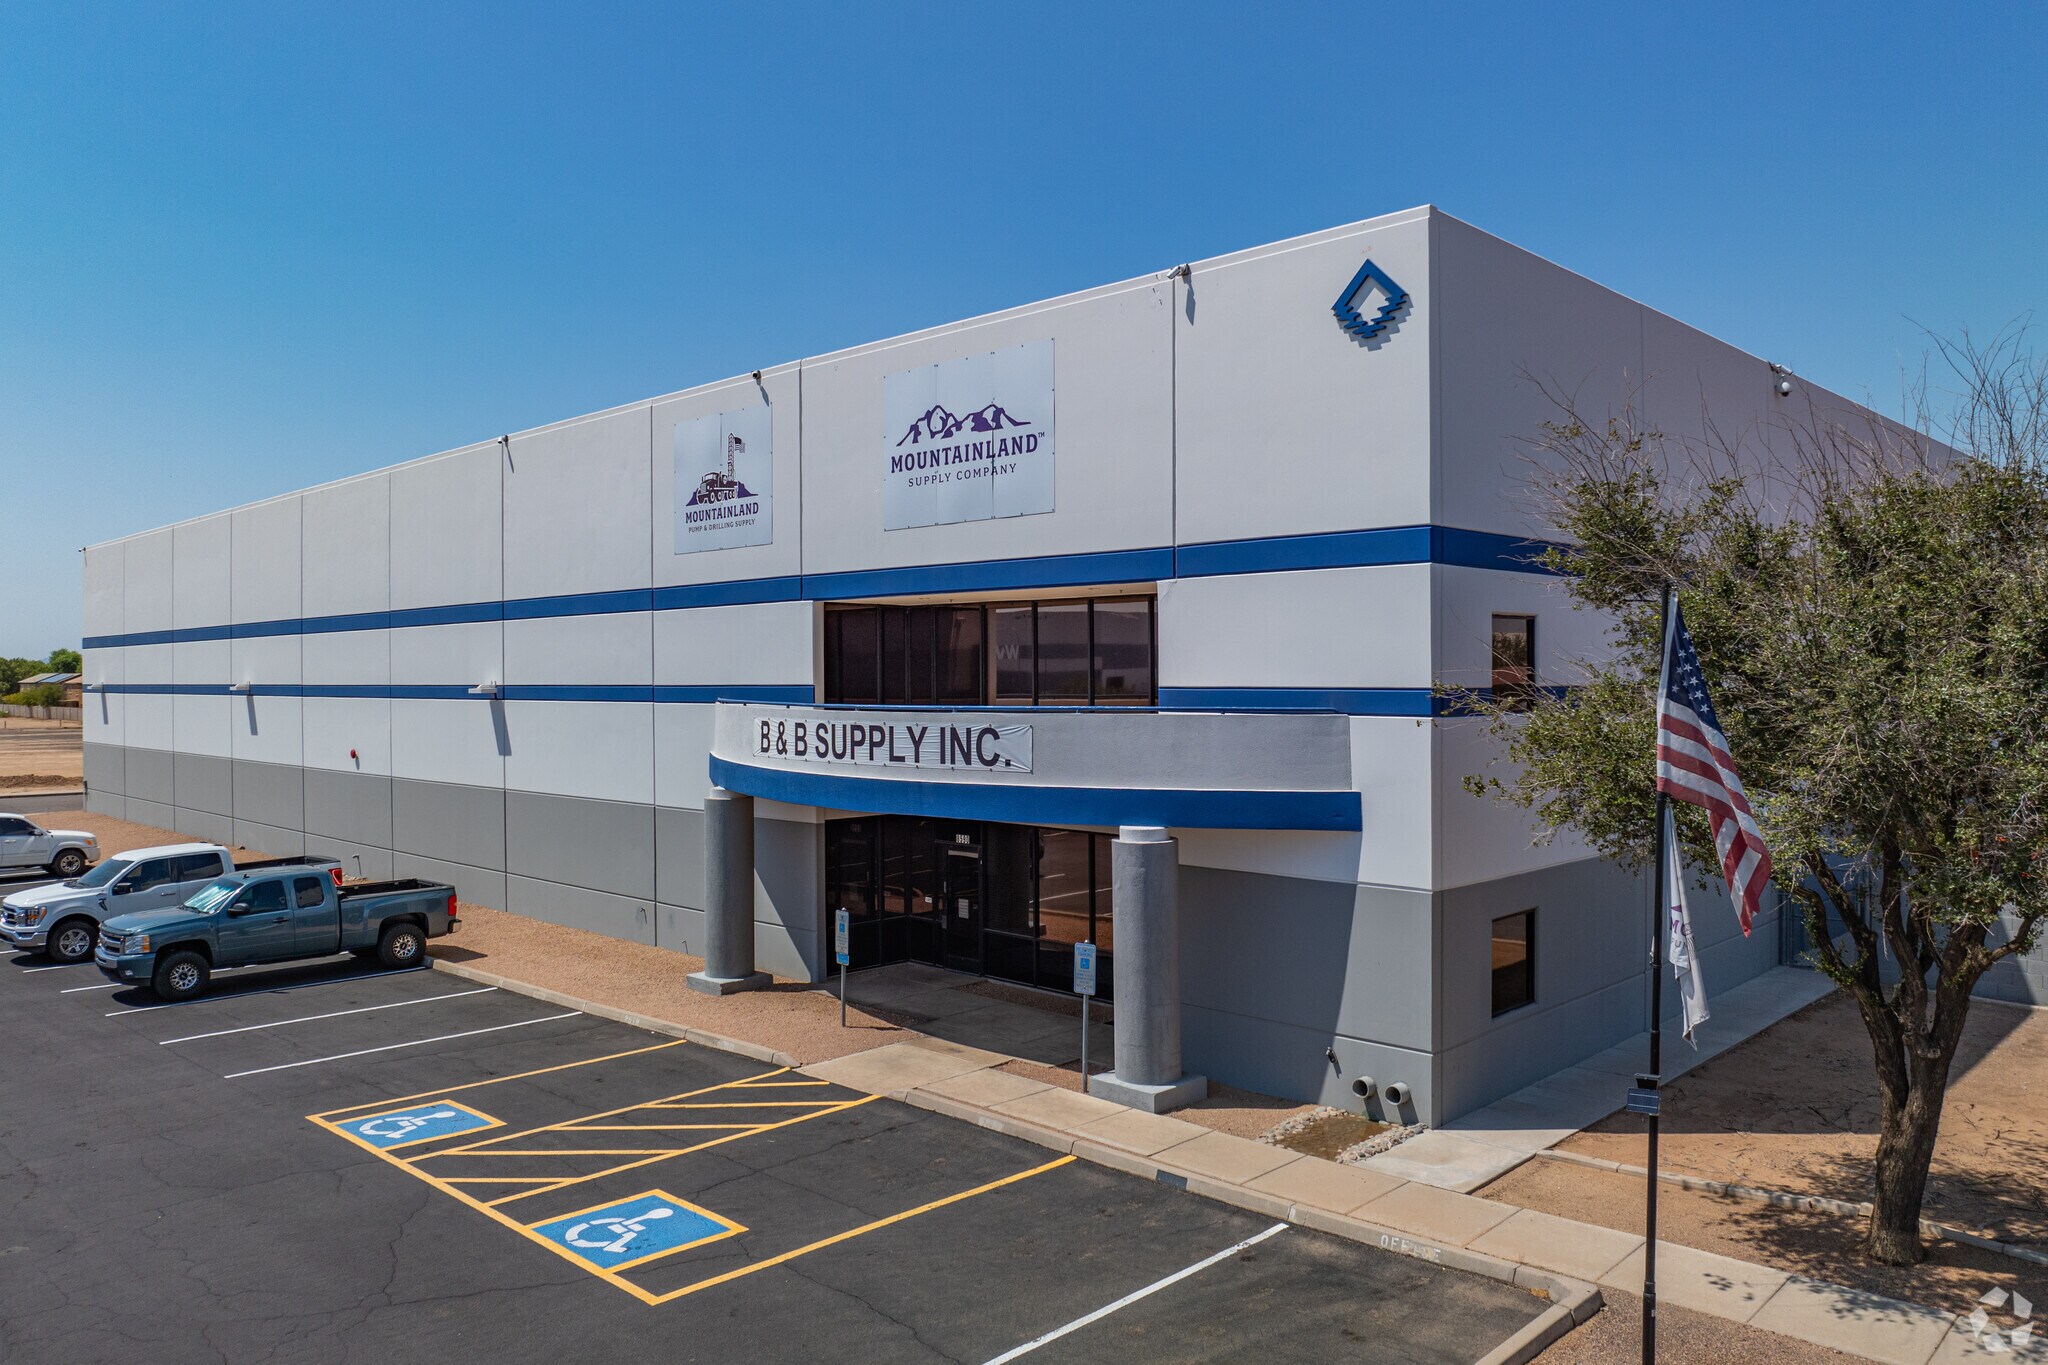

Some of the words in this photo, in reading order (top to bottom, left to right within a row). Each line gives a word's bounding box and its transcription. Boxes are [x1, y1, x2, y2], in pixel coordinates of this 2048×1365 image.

[891, 433, 1038, 473] MOUNTAINLAND
[908, 472, 951, 487] SUPPLY
[956, 463, 1017, 480] COMPANY
[685, 502, 759, 524] MOUNTAINLAND
[688, 525, 702, 533] PUMP
[708, 521, 734, 531] DRILLING
[735, 519, 756, 527] SUPPLY
[760, 720, 770, 753] B
[776, 720, 788, 755] &
[794, 722, 808, 756] B
[815, 723, 928, 763] SUPPLY
[939, 726, 1012, 767] INC.
